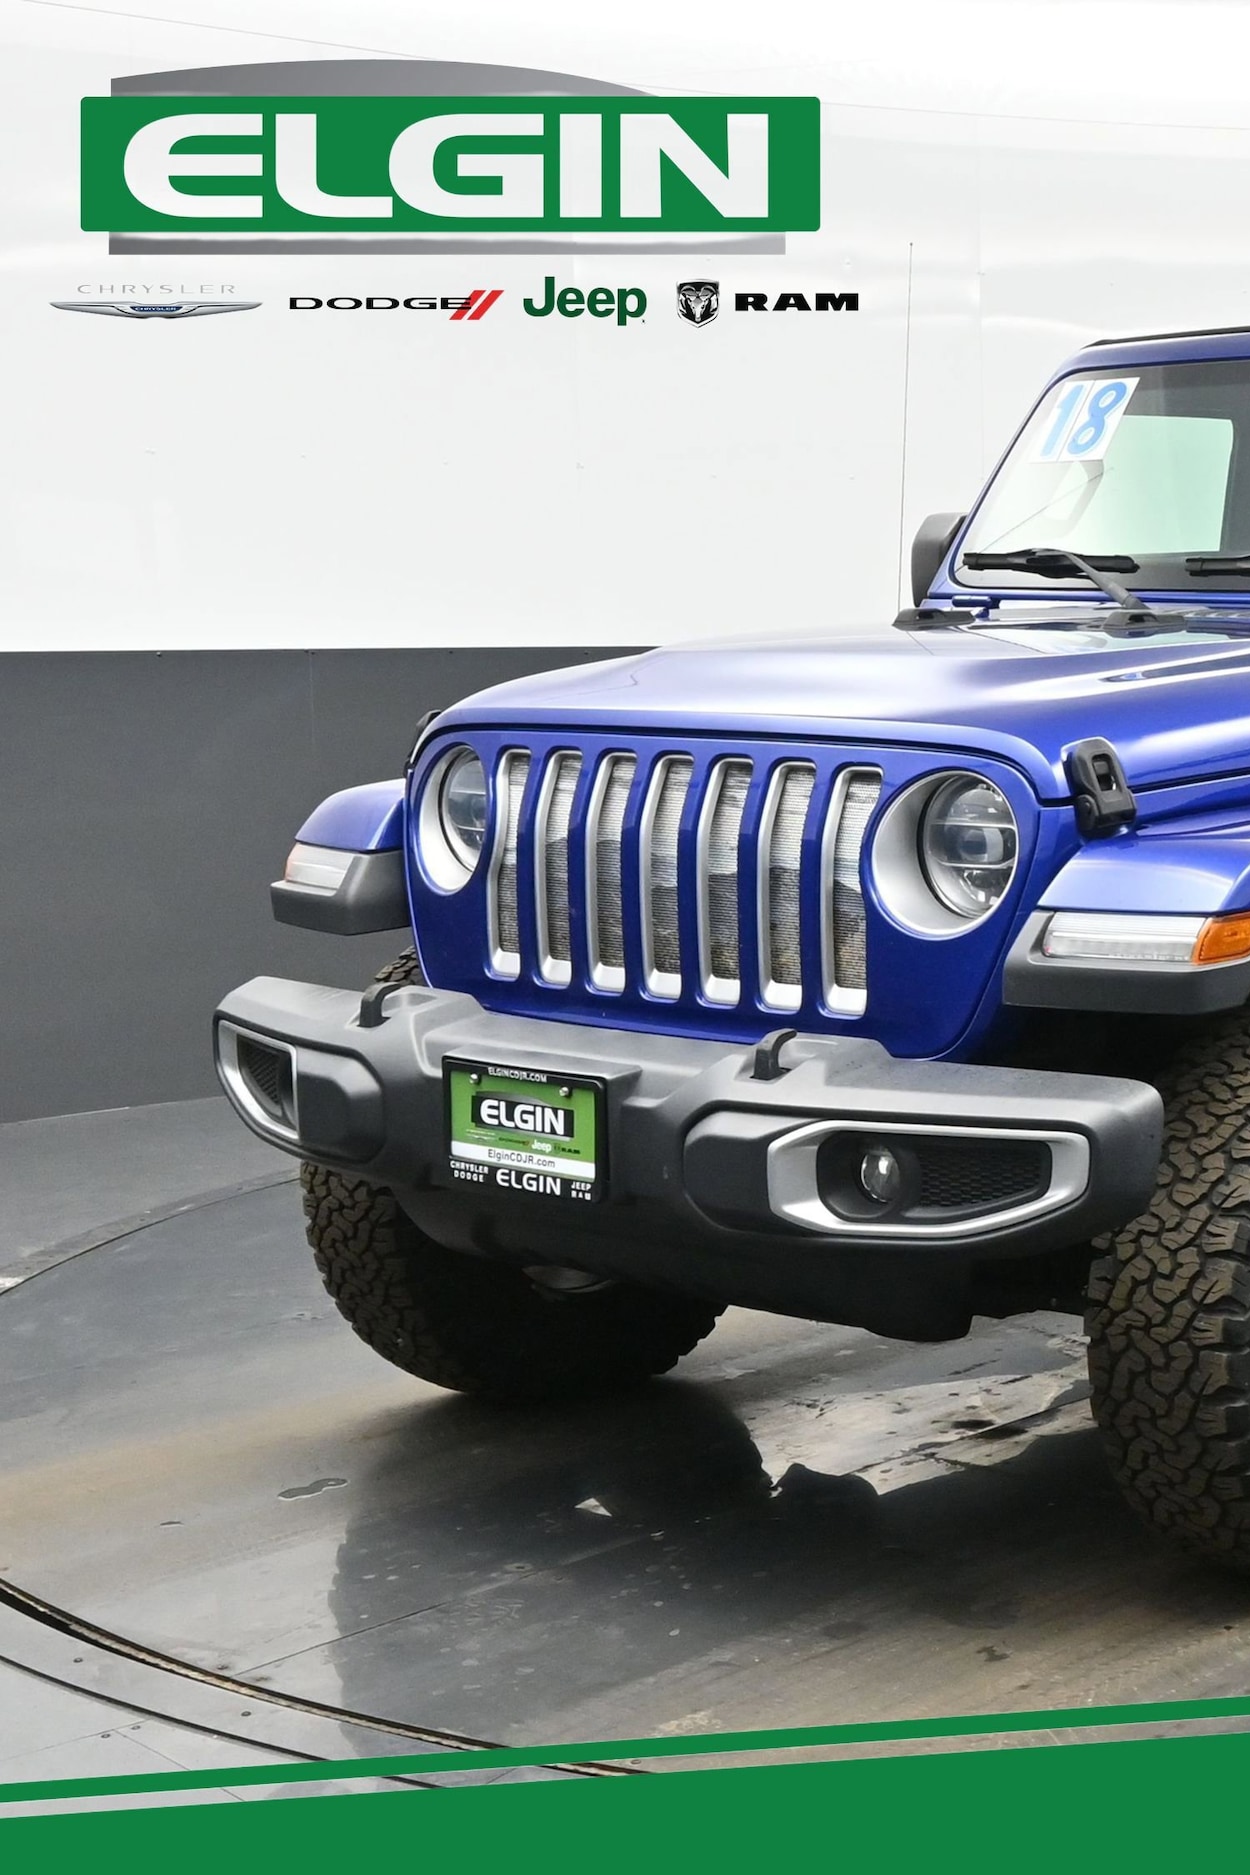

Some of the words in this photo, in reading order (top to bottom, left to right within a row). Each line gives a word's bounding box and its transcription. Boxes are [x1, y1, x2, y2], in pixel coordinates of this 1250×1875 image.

[1039, 381, 1127, 457] 18
[488, 1066, 548, 1083] ELGINCDJR.COM
[480, 1099, 565, 1135] ELGIN
[532, 1139, 552, 1153] Jeep
[450, 1160, 489, 1174] CHRYSLER
[488, 1149, 556, 1168] ElginCDJR.com
[454, 1170, 485, 1183] DODGE
[496, 1168, 561, 1196] ELGIN
[571, 1181, 592, 1191] JEEP
